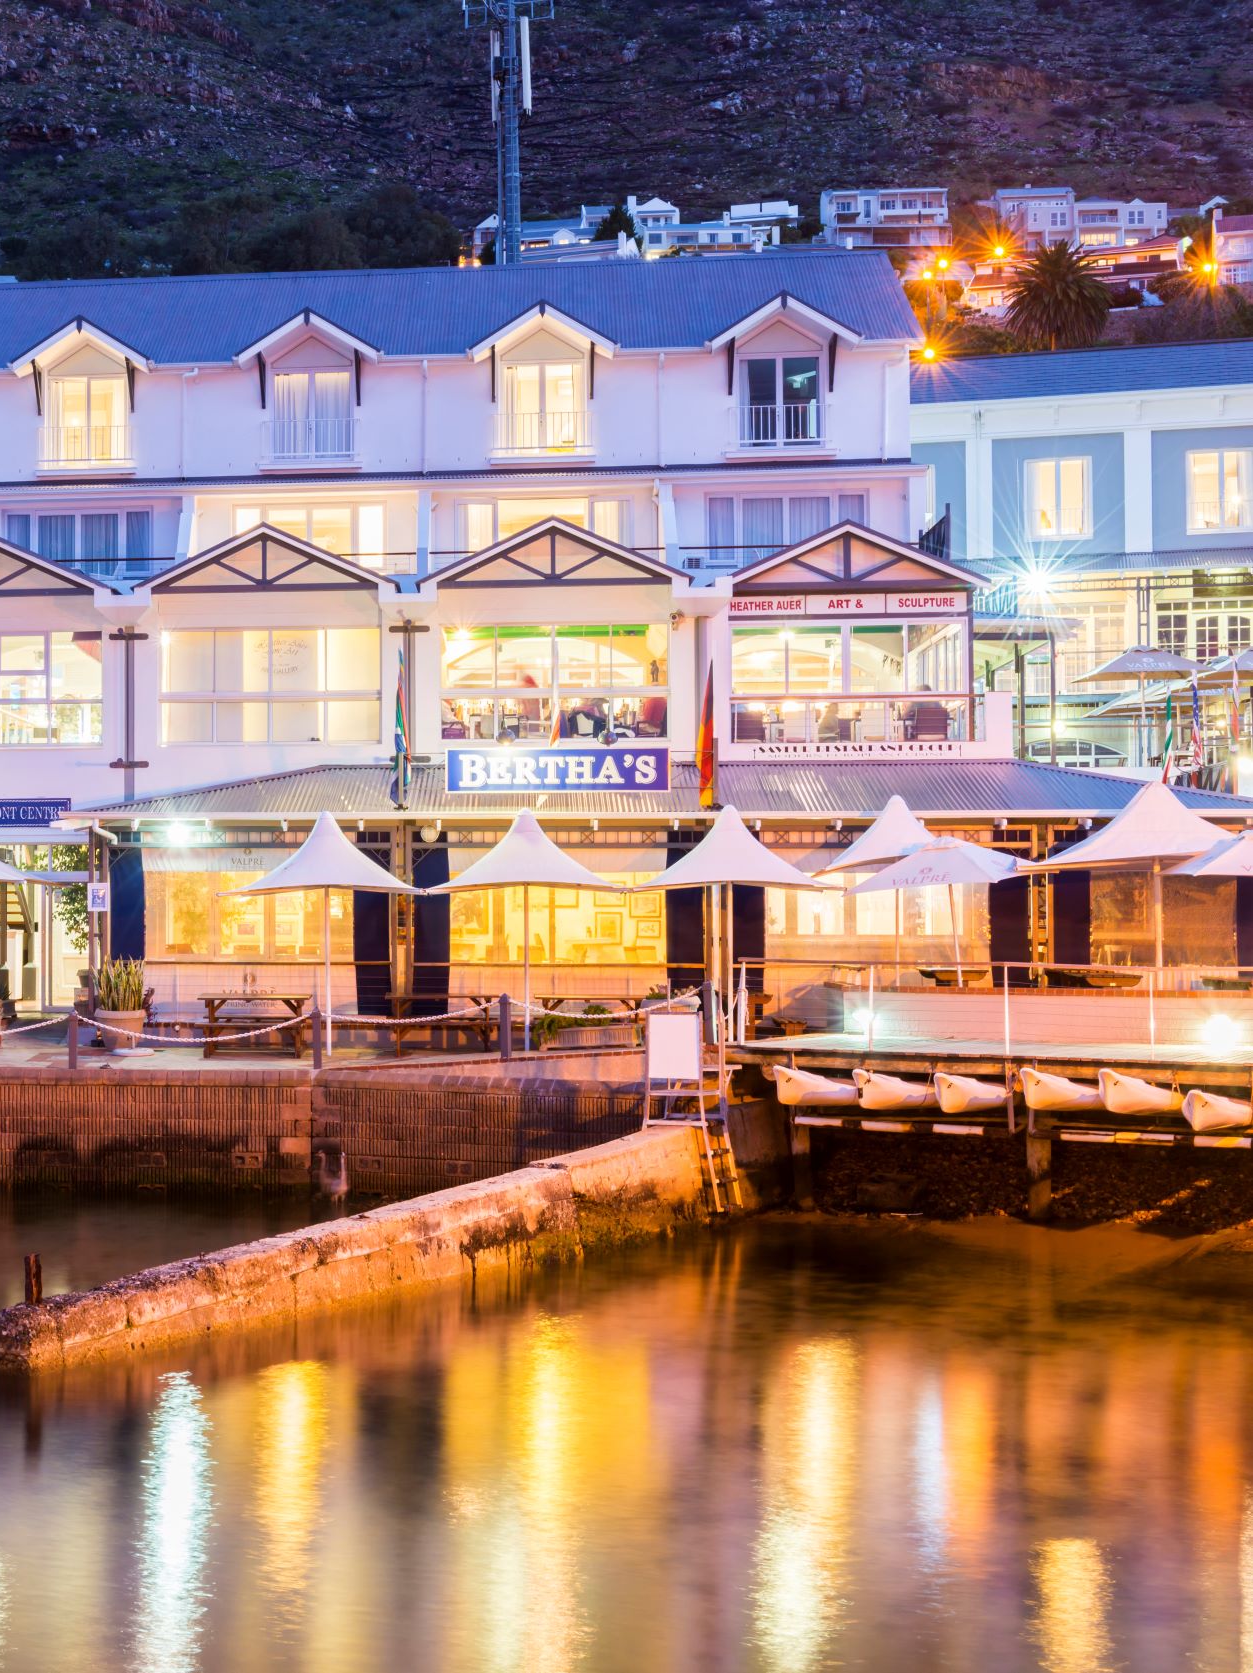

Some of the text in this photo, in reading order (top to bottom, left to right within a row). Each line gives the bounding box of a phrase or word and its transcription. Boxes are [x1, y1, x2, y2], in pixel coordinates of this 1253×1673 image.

[729, 597, 955, 612] HEATHER AUER ART & SCULPTURE
[458, 754, 658, 788] BERTHA'S
